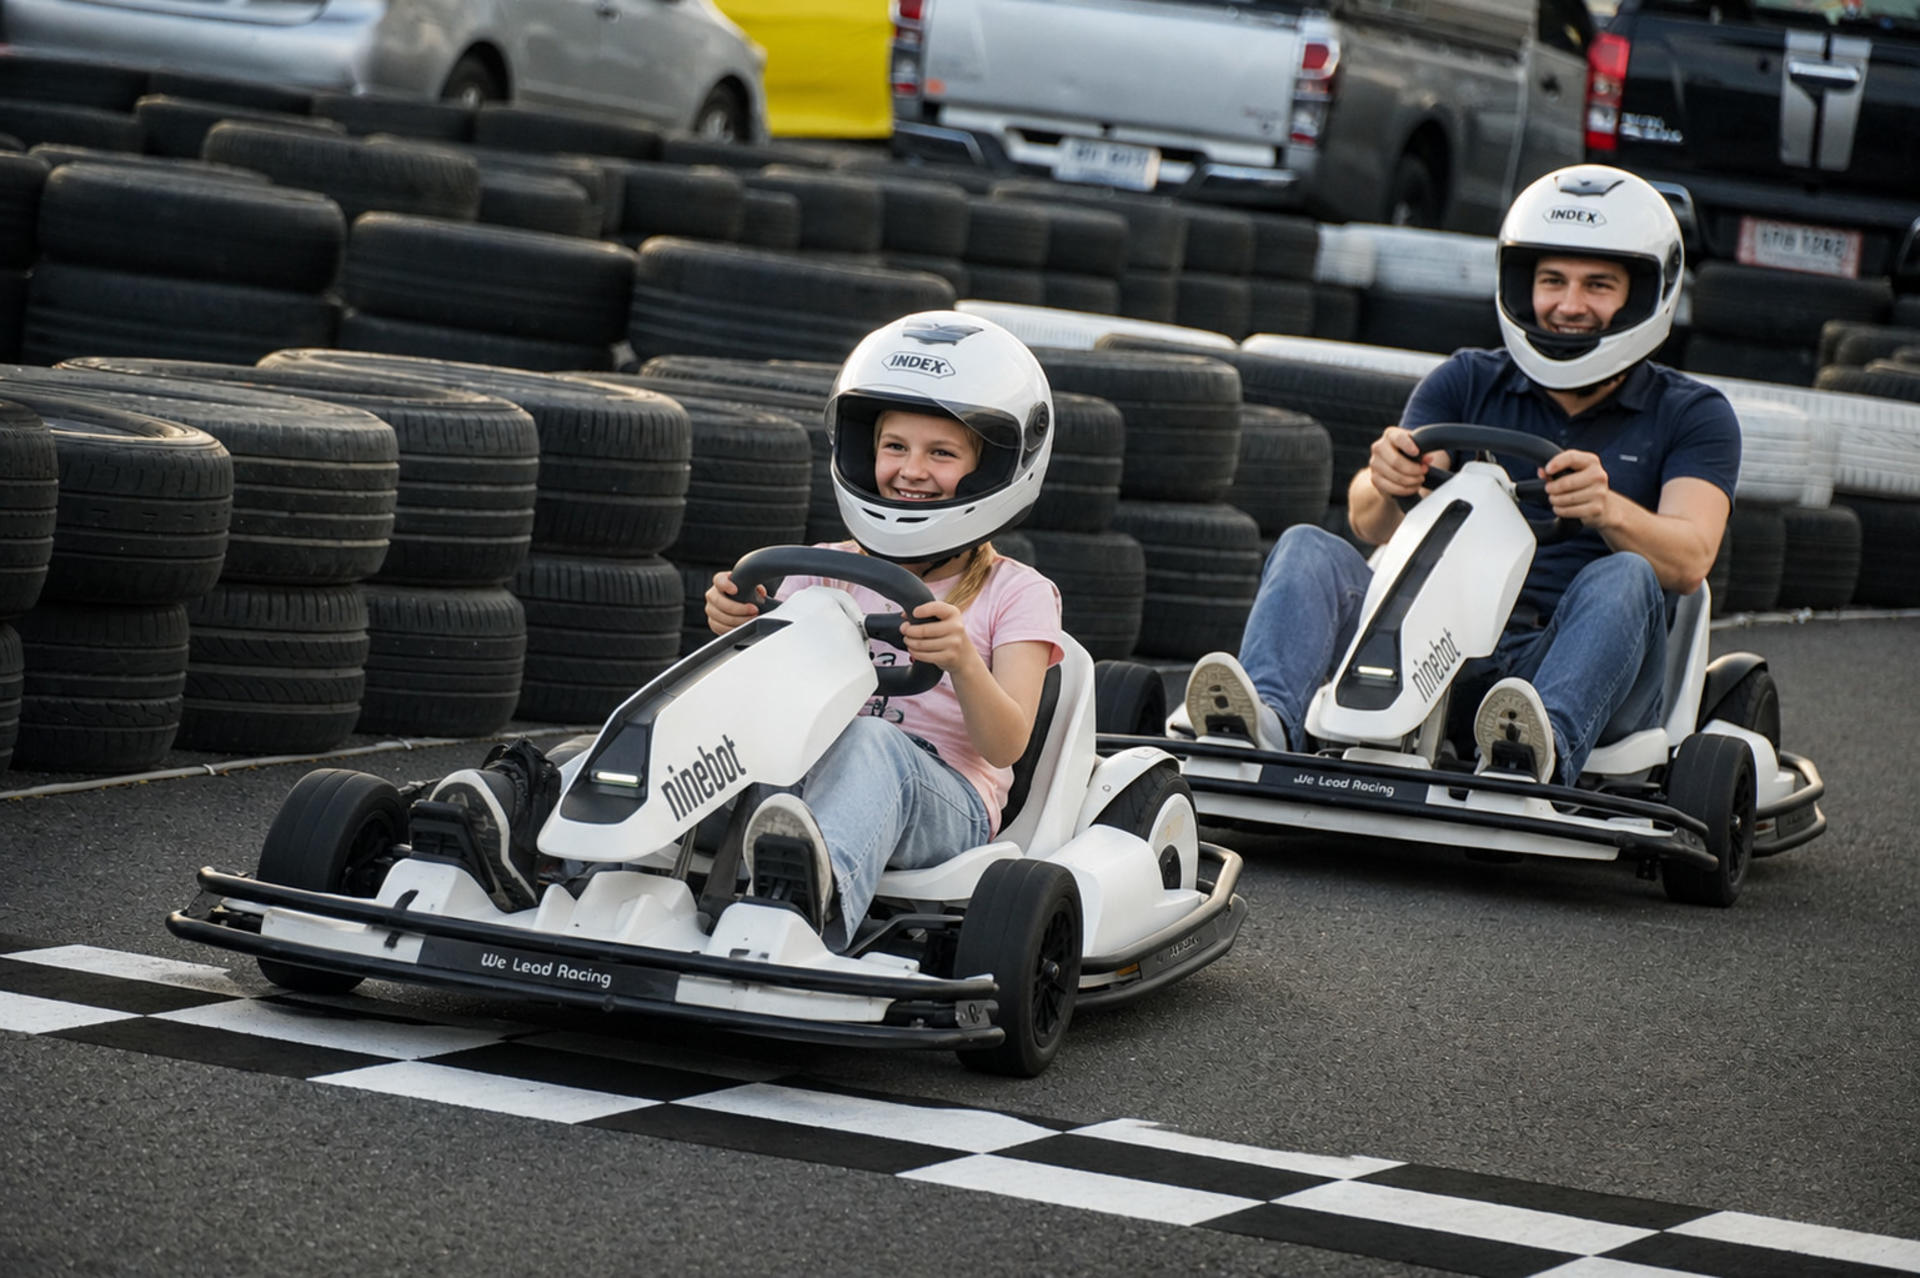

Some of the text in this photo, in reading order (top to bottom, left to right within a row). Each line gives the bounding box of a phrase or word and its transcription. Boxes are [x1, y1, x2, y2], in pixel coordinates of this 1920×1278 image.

[1550, 209, 1597, 224] INDEX
[890, 354, 946, 374] INDEX
[1412, 627, 1461, 703] ninebot
[661, 734, 747, 822] ninebot
[1352, 779, 1395, 798] Racing
[481, 953, 612, 988] We Lead Racing
